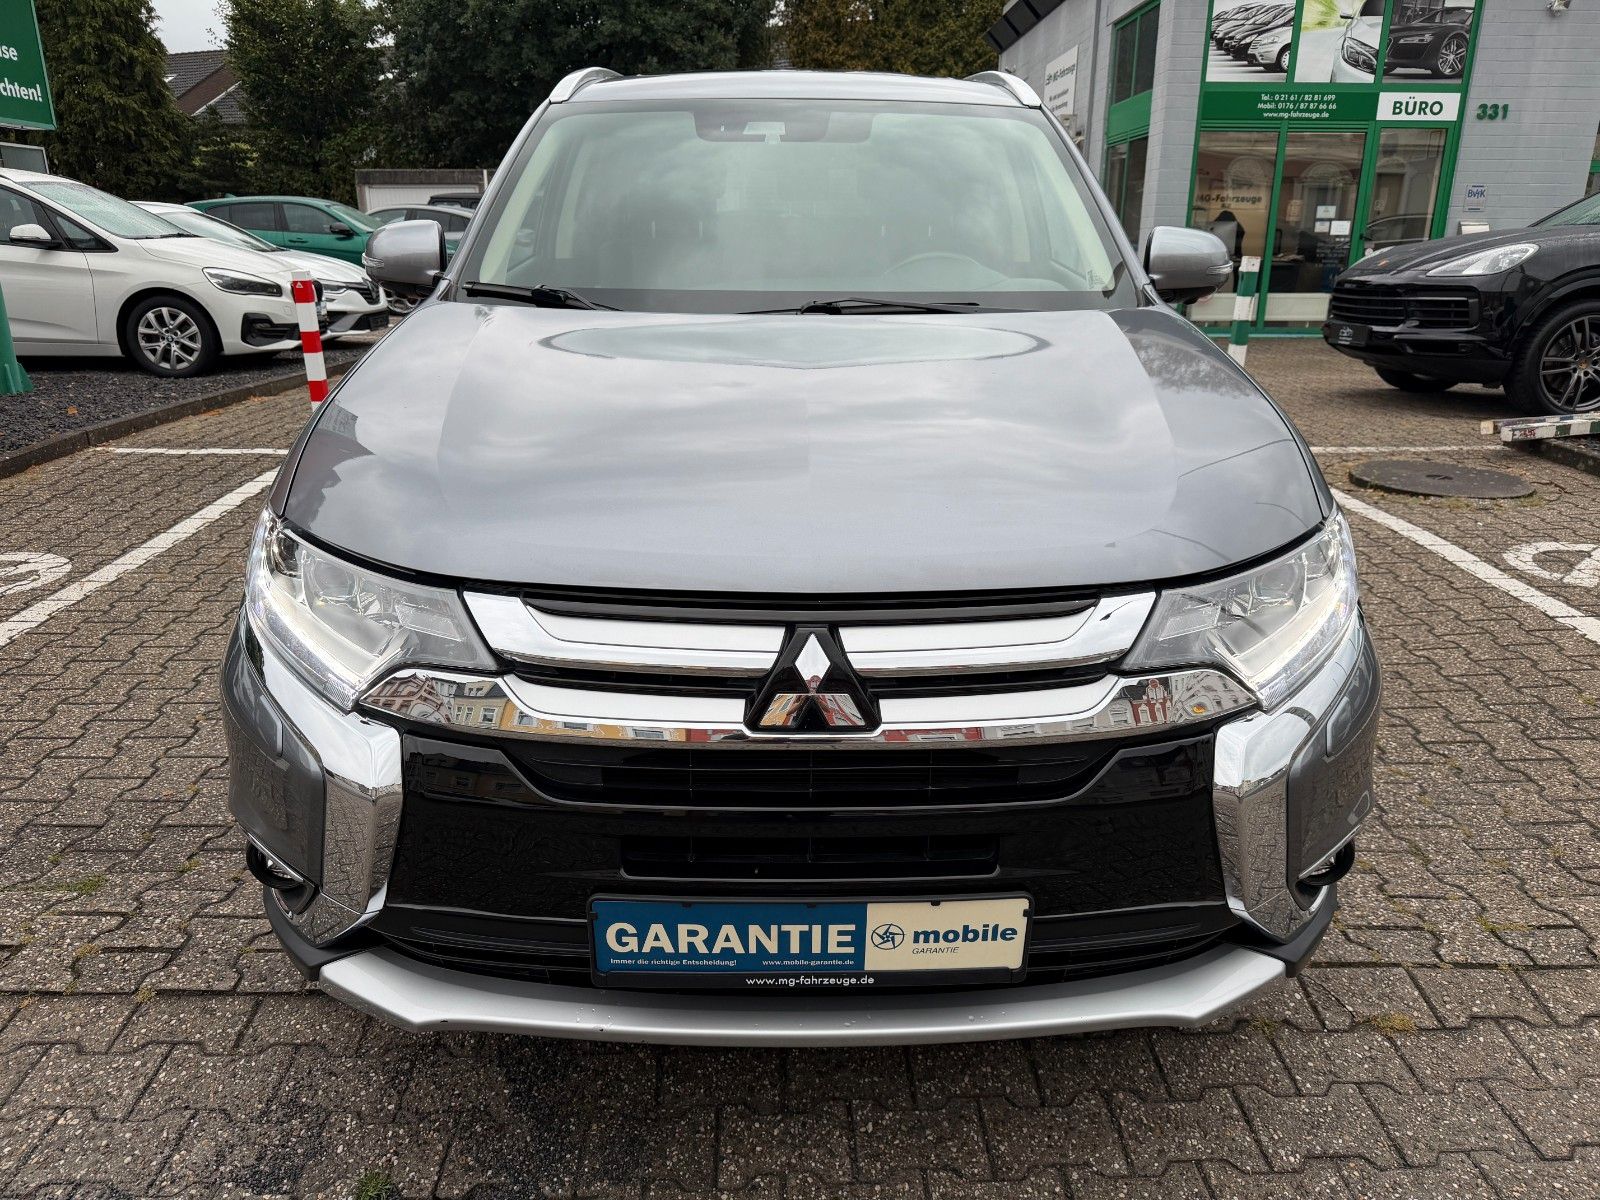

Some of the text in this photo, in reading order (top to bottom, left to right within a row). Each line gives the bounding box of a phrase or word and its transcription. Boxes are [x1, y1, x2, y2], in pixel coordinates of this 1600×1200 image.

[0, 45, 18, 61] se
[1261, 93, 1274, 101] Tel.:
[1257, 102, 1277, 110] Mobil:
[1277, 102, 1294, 110] 0176
[1299, 102, 1308, 110] 87
[1309, 102, 1318, 110] 87
[1318, 102, 1327, 110] 66
[1328, 102, 1337, 110] 66
[1392, 96, 1444, 116] BÜRO
[1476, 103, 1509, 121] 331
[1263, 111, 1330, 120] www.mg-fahrzeuge.de
[605, 922, 856, 954] GARANTIE
[912, 923, 1018, 944] mobile
[911, 946, 960, 955] GARANTIE
[682, 959, 737, 967] Entscheidung!
[745, 974, 875, 987] www.mg-fahrzeuge.de
